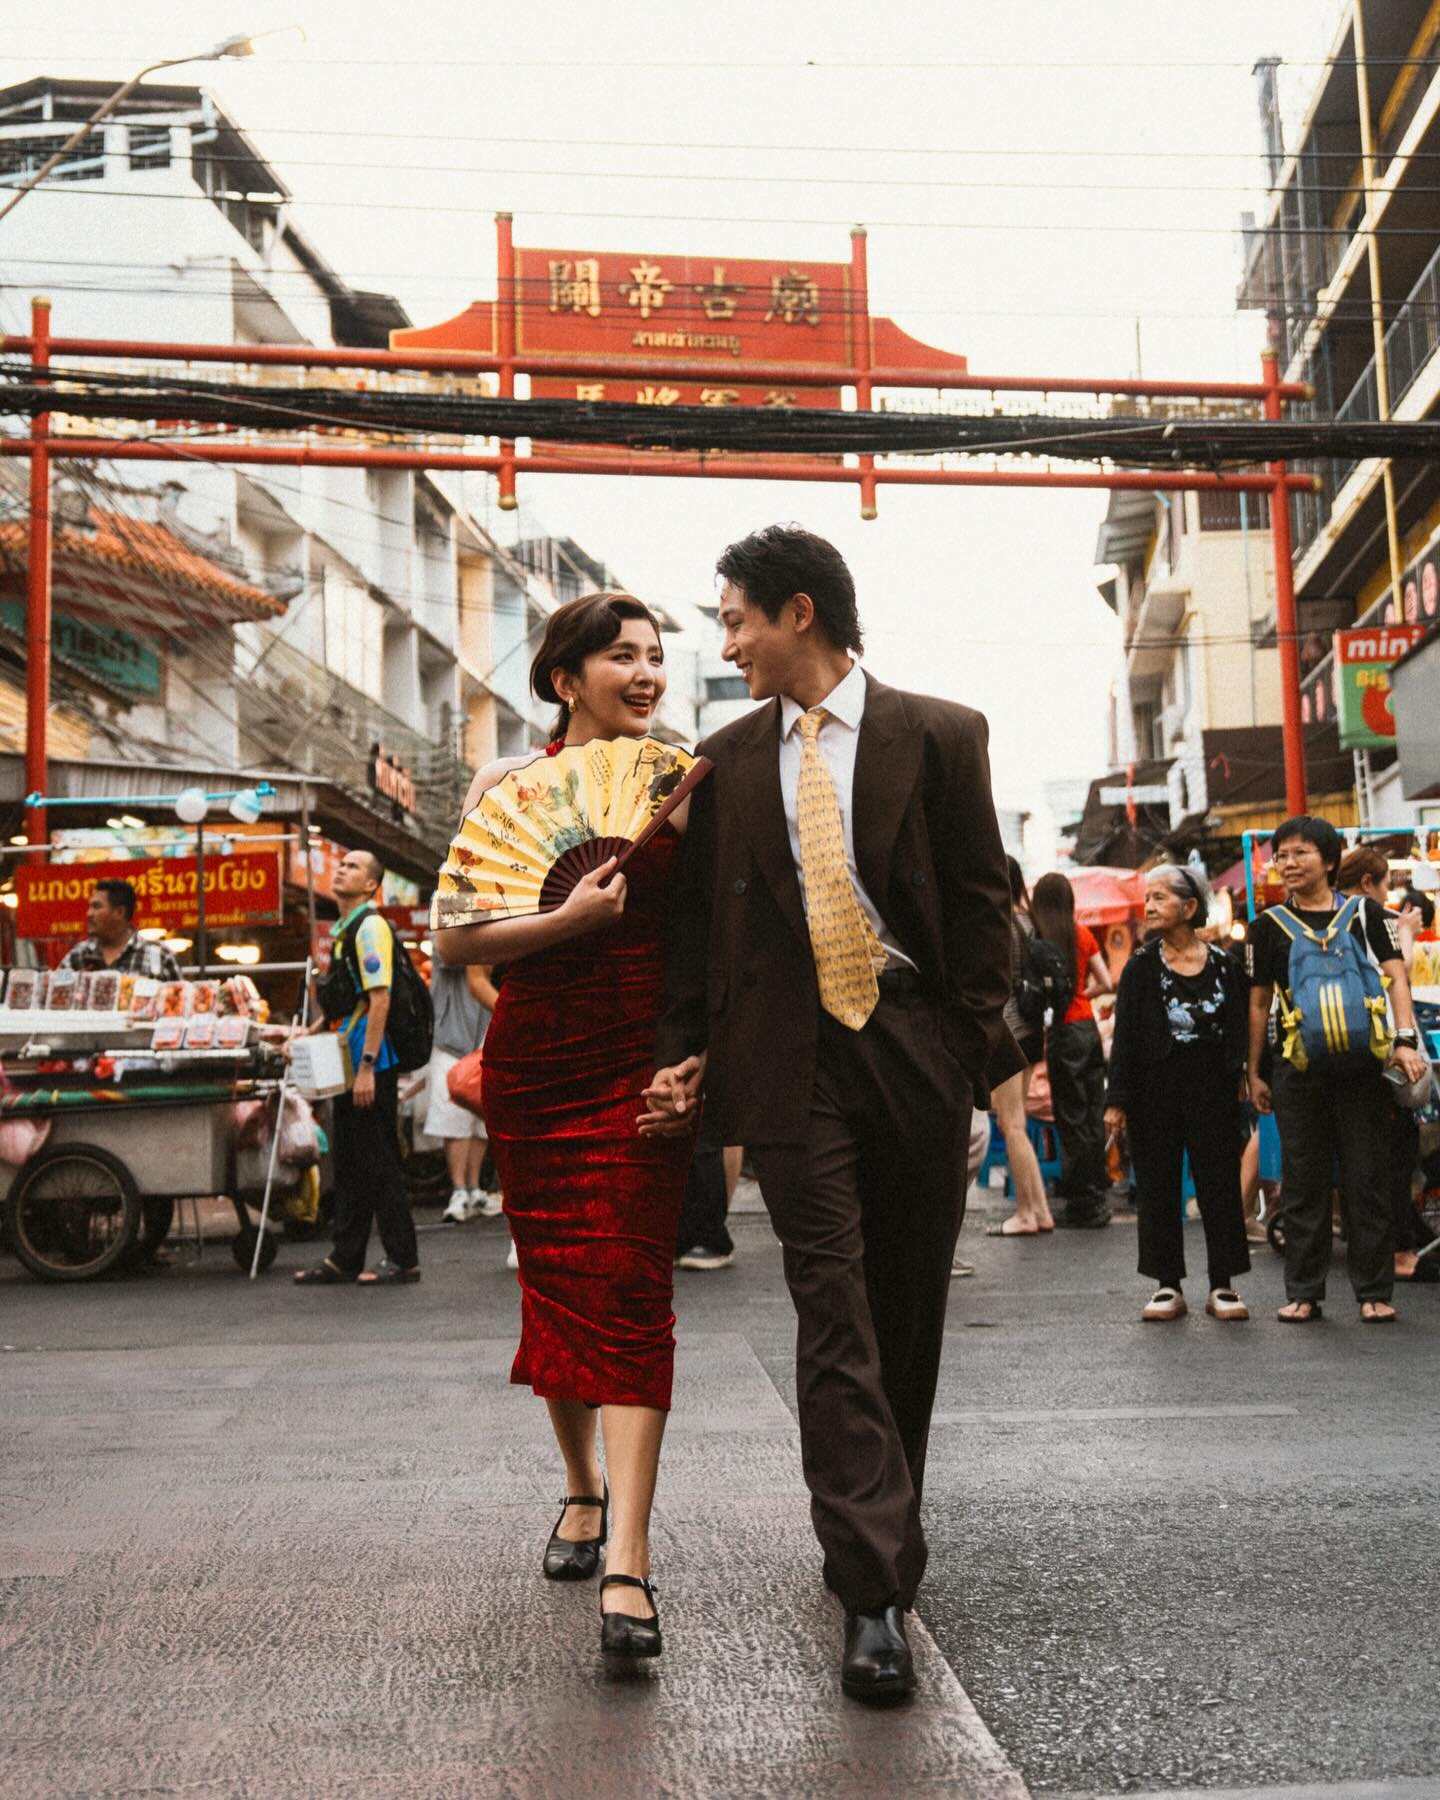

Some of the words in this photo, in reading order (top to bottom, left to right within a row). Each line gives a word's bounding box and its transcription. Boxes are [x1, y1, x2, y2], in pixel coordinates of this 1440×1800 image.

[28, 856, 267, 902] แกงกหรี่นายโย่ง
